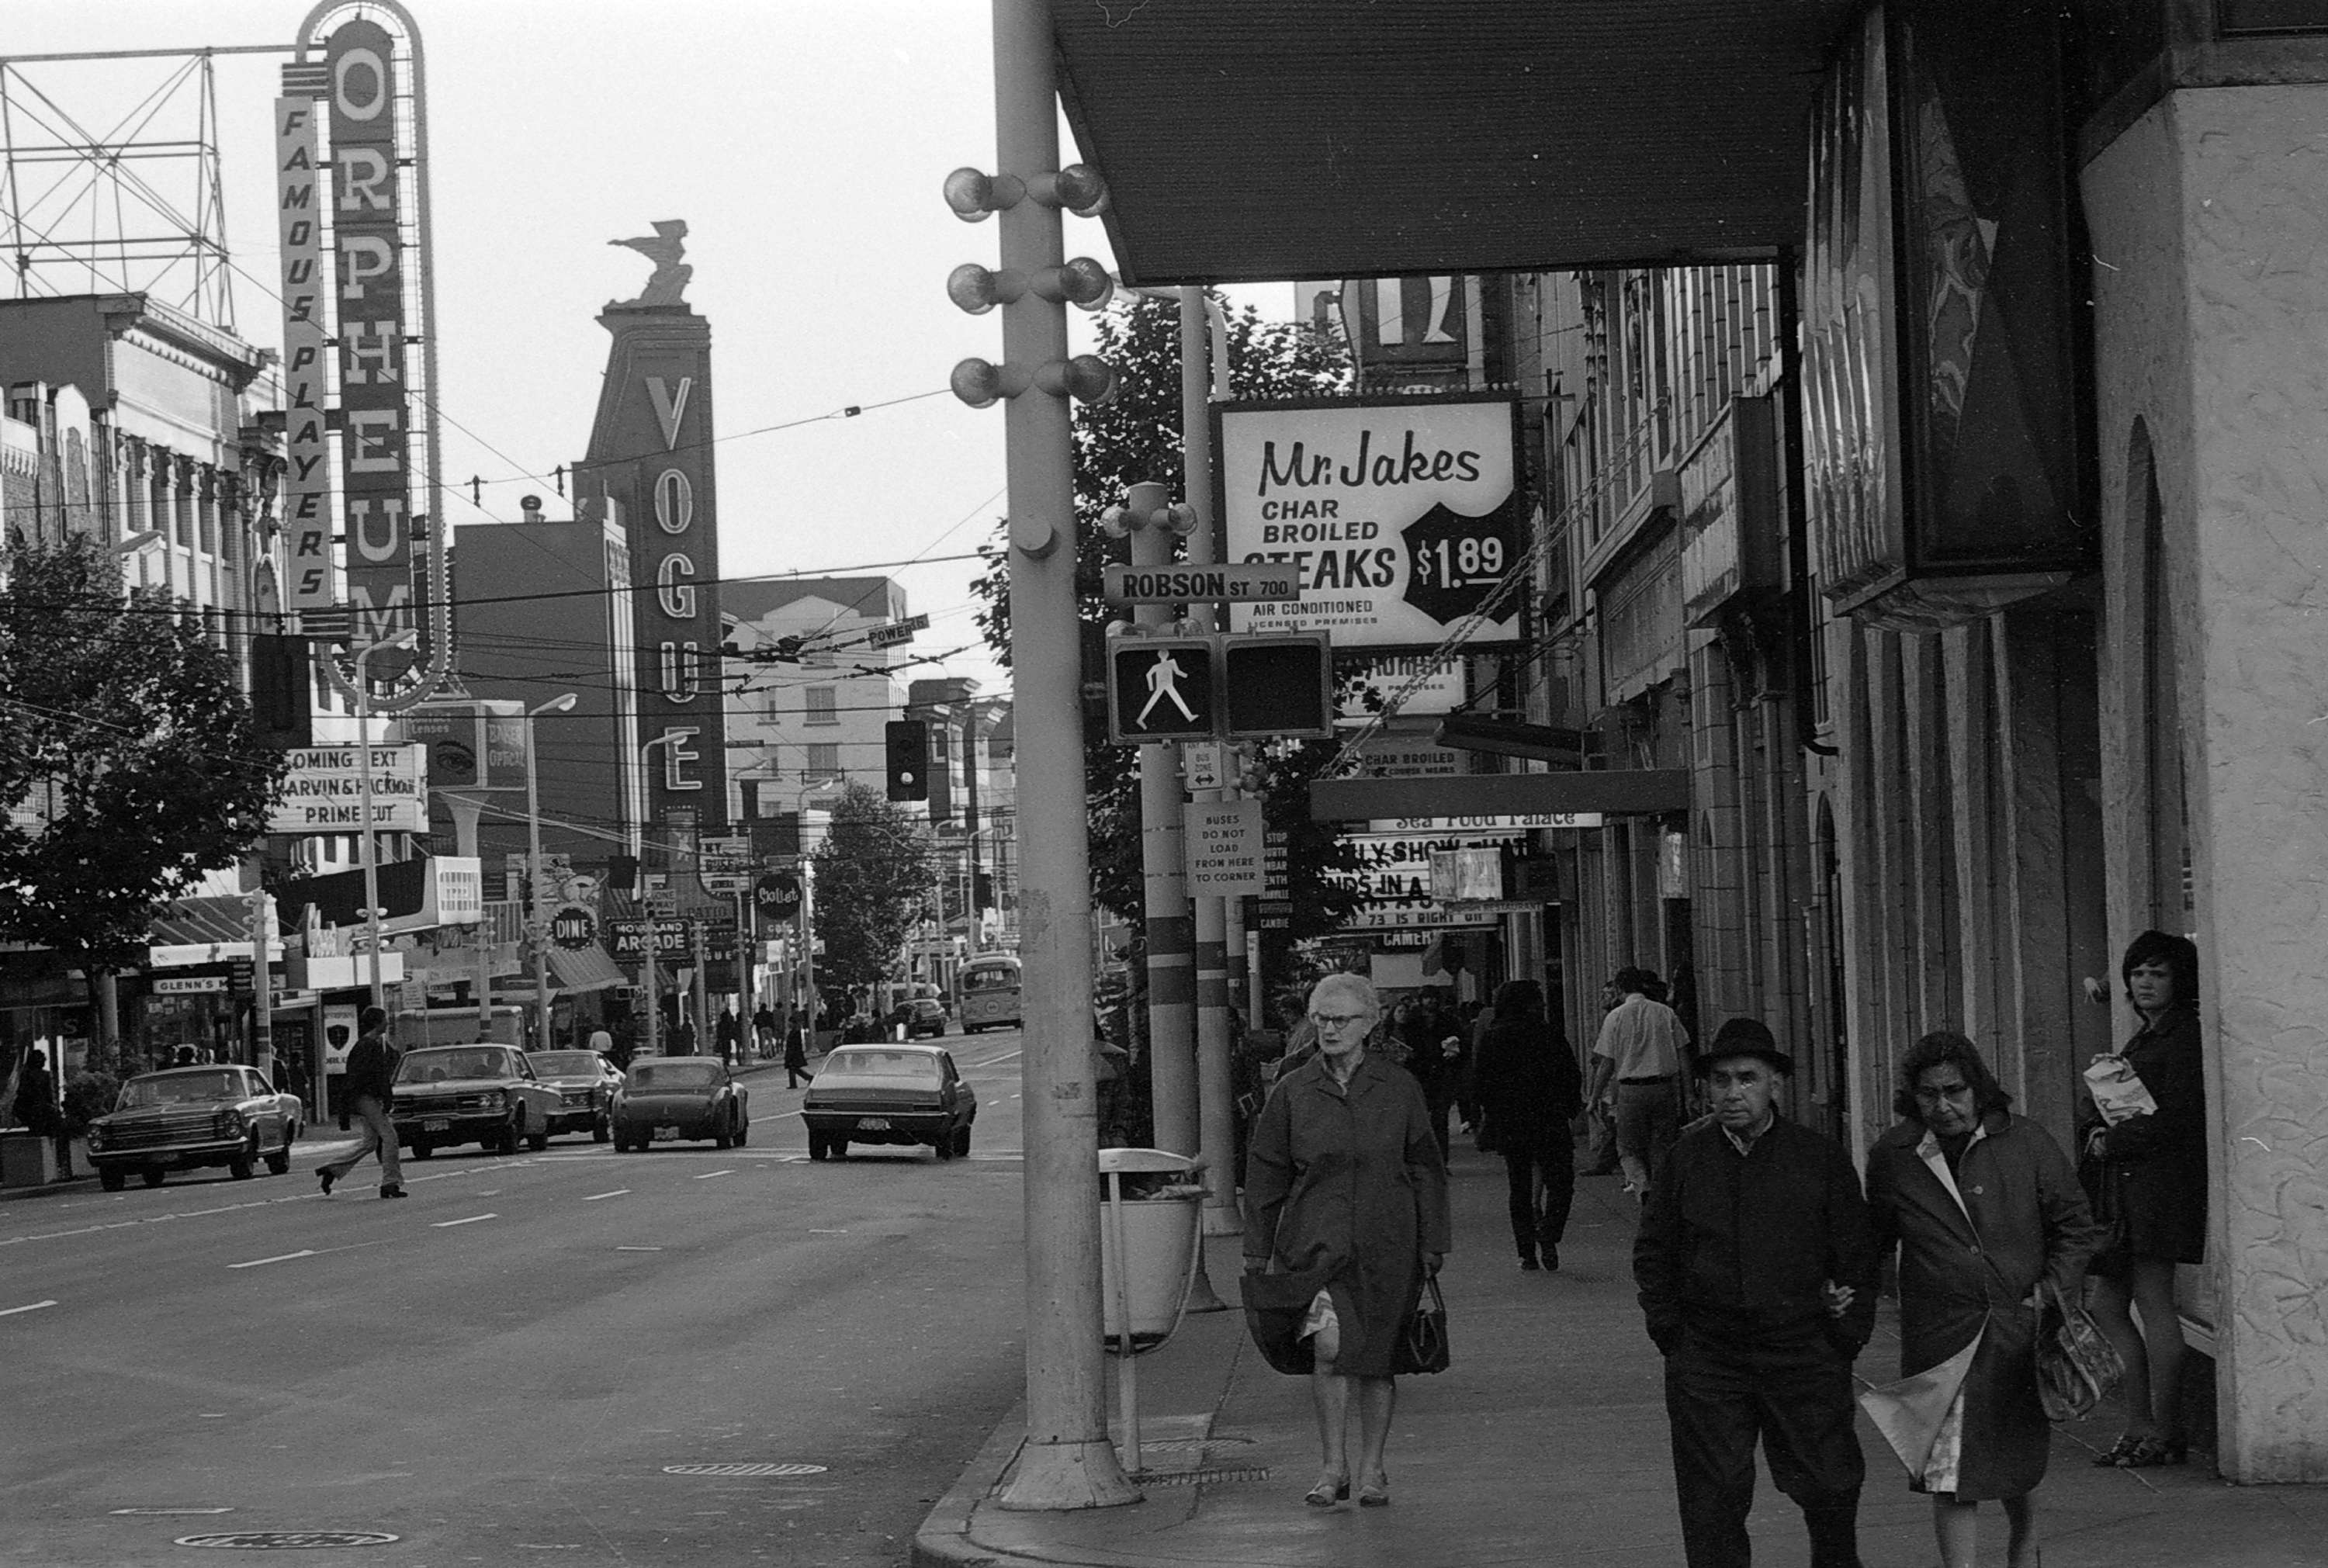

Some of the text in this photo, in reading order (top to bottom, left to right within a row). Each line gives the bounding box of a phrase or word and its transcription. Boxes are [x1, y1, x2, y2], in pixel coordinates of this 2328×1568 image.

[282, 111, 314, 323] FAMOUS
[335, 48, 409, 649] ORPHEUM
[1340, 430, 1481, 487] Jakes
[292, 346, 324, 594] PLAYERS
[1262, 500, 1339, 521] CHAR
[1263, 522, 1378, 544] BROILED
[1242, 548, 1396, 590] EAKS
[646, 376, 702, 791] VOGUE
[1123, 573, 1288, 598] ROBSON ST 700
[1253, 600, 1373, 616] AIR CONDITIONED
[1248, 618, 1377, 628] LICENSED PREMISES
[869, 625, 913, 645] POWER
[1366, 753, 1455, 766] CHAR BROILED
[1206, 815, 1239, 825] BUSES
[1202, 829, 1245, 839] DO NOT
[1266, 832, 1287, 843] STOP
[1211, 843, 1238, 853] LOAD
[1195, 857, 1255, 868] FROM HERE
[1195, 871, 1256, 882] TO CORNER
[1369, 915, 1385, 926] 73
[1396, 913, 1408, 925] IS
[556, 919, 589, 939] DINE
[160, 979, 213, 990] GLENN'S
